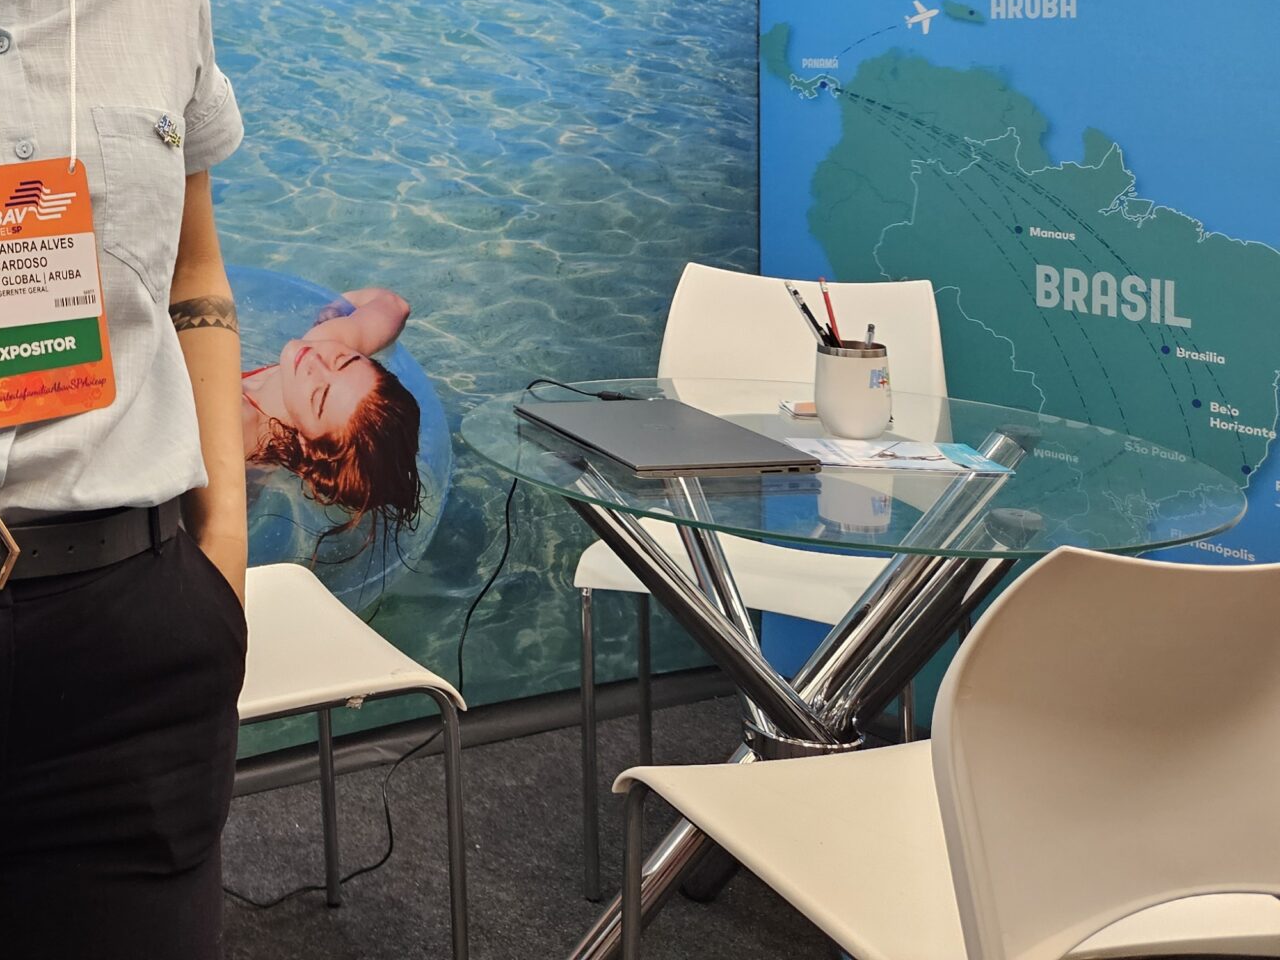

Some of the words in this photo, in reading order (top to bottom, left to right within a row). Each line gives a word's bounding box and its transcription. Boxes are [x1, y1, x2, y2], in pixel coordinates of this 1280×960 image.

[1030, 226, 1076, 242] Manaus
[40, 237, 74, 252] ALVES
[1, 274, 41, 286] GLOBAL
[48, 269, 82, 281] ARUBA
[28, 286, 49, 294] GERAL
[1035, 264, 1192, 328] BRASIL
[1209, 401, 1240, 417] Belo
[1209, 416, 1277, 439] Horizonte
[1151, 446, 1187, 463] Paulo
